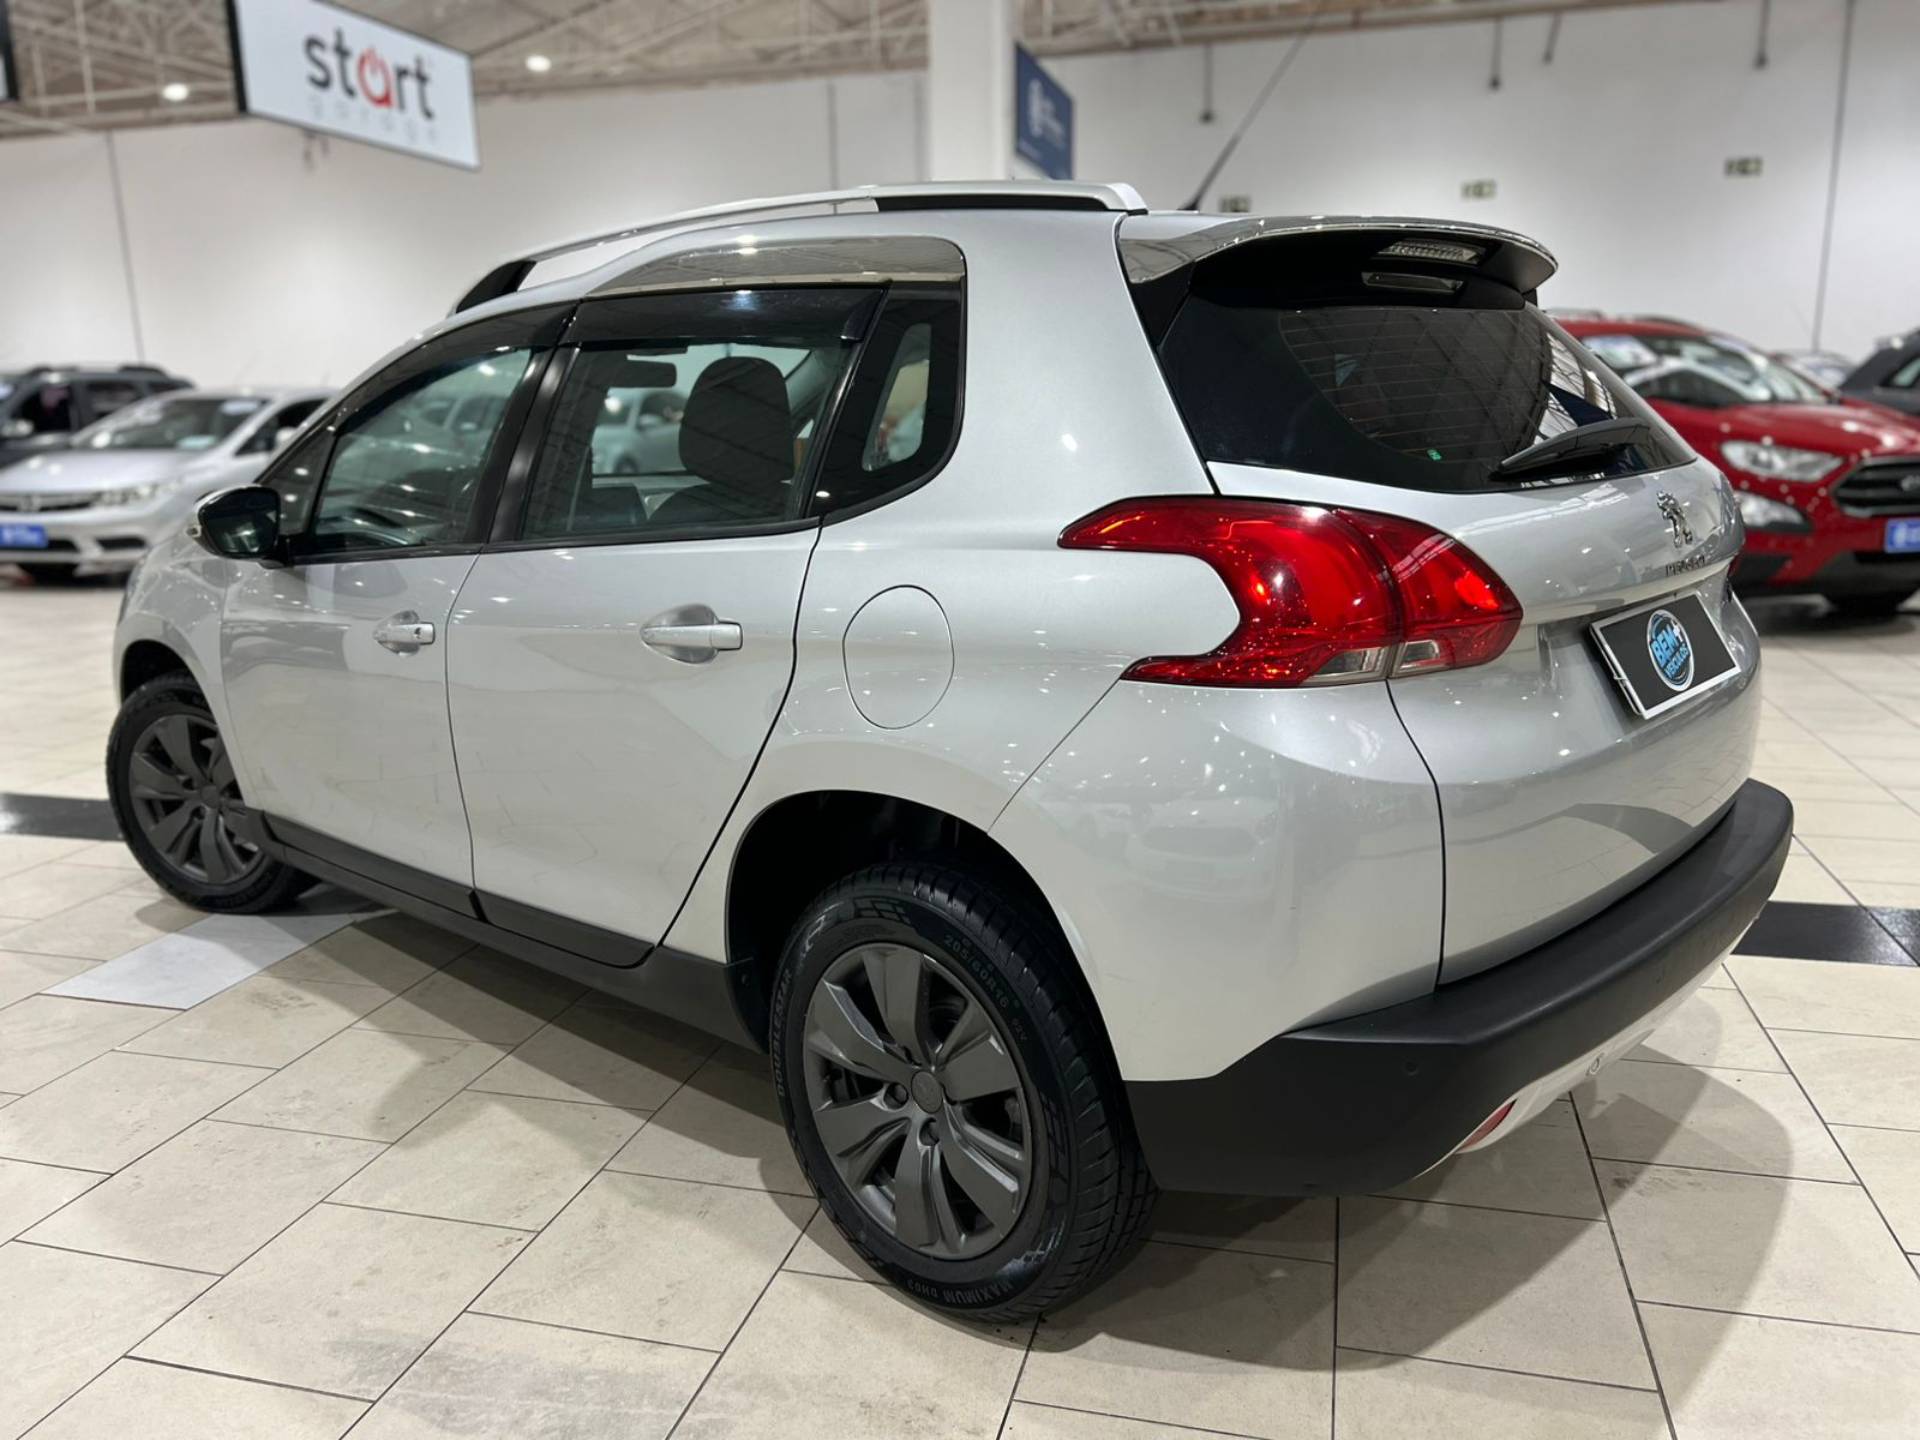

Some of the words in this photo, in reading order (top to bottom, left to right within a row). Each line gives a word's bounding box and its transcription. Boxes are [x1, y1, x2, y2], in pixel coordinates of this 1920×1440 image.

[303, 27, 434, 120] start
[773, 968, 792, 1098] DOUBLESTAR
[942, 1280, 1014, 1304] MAXIMUM
